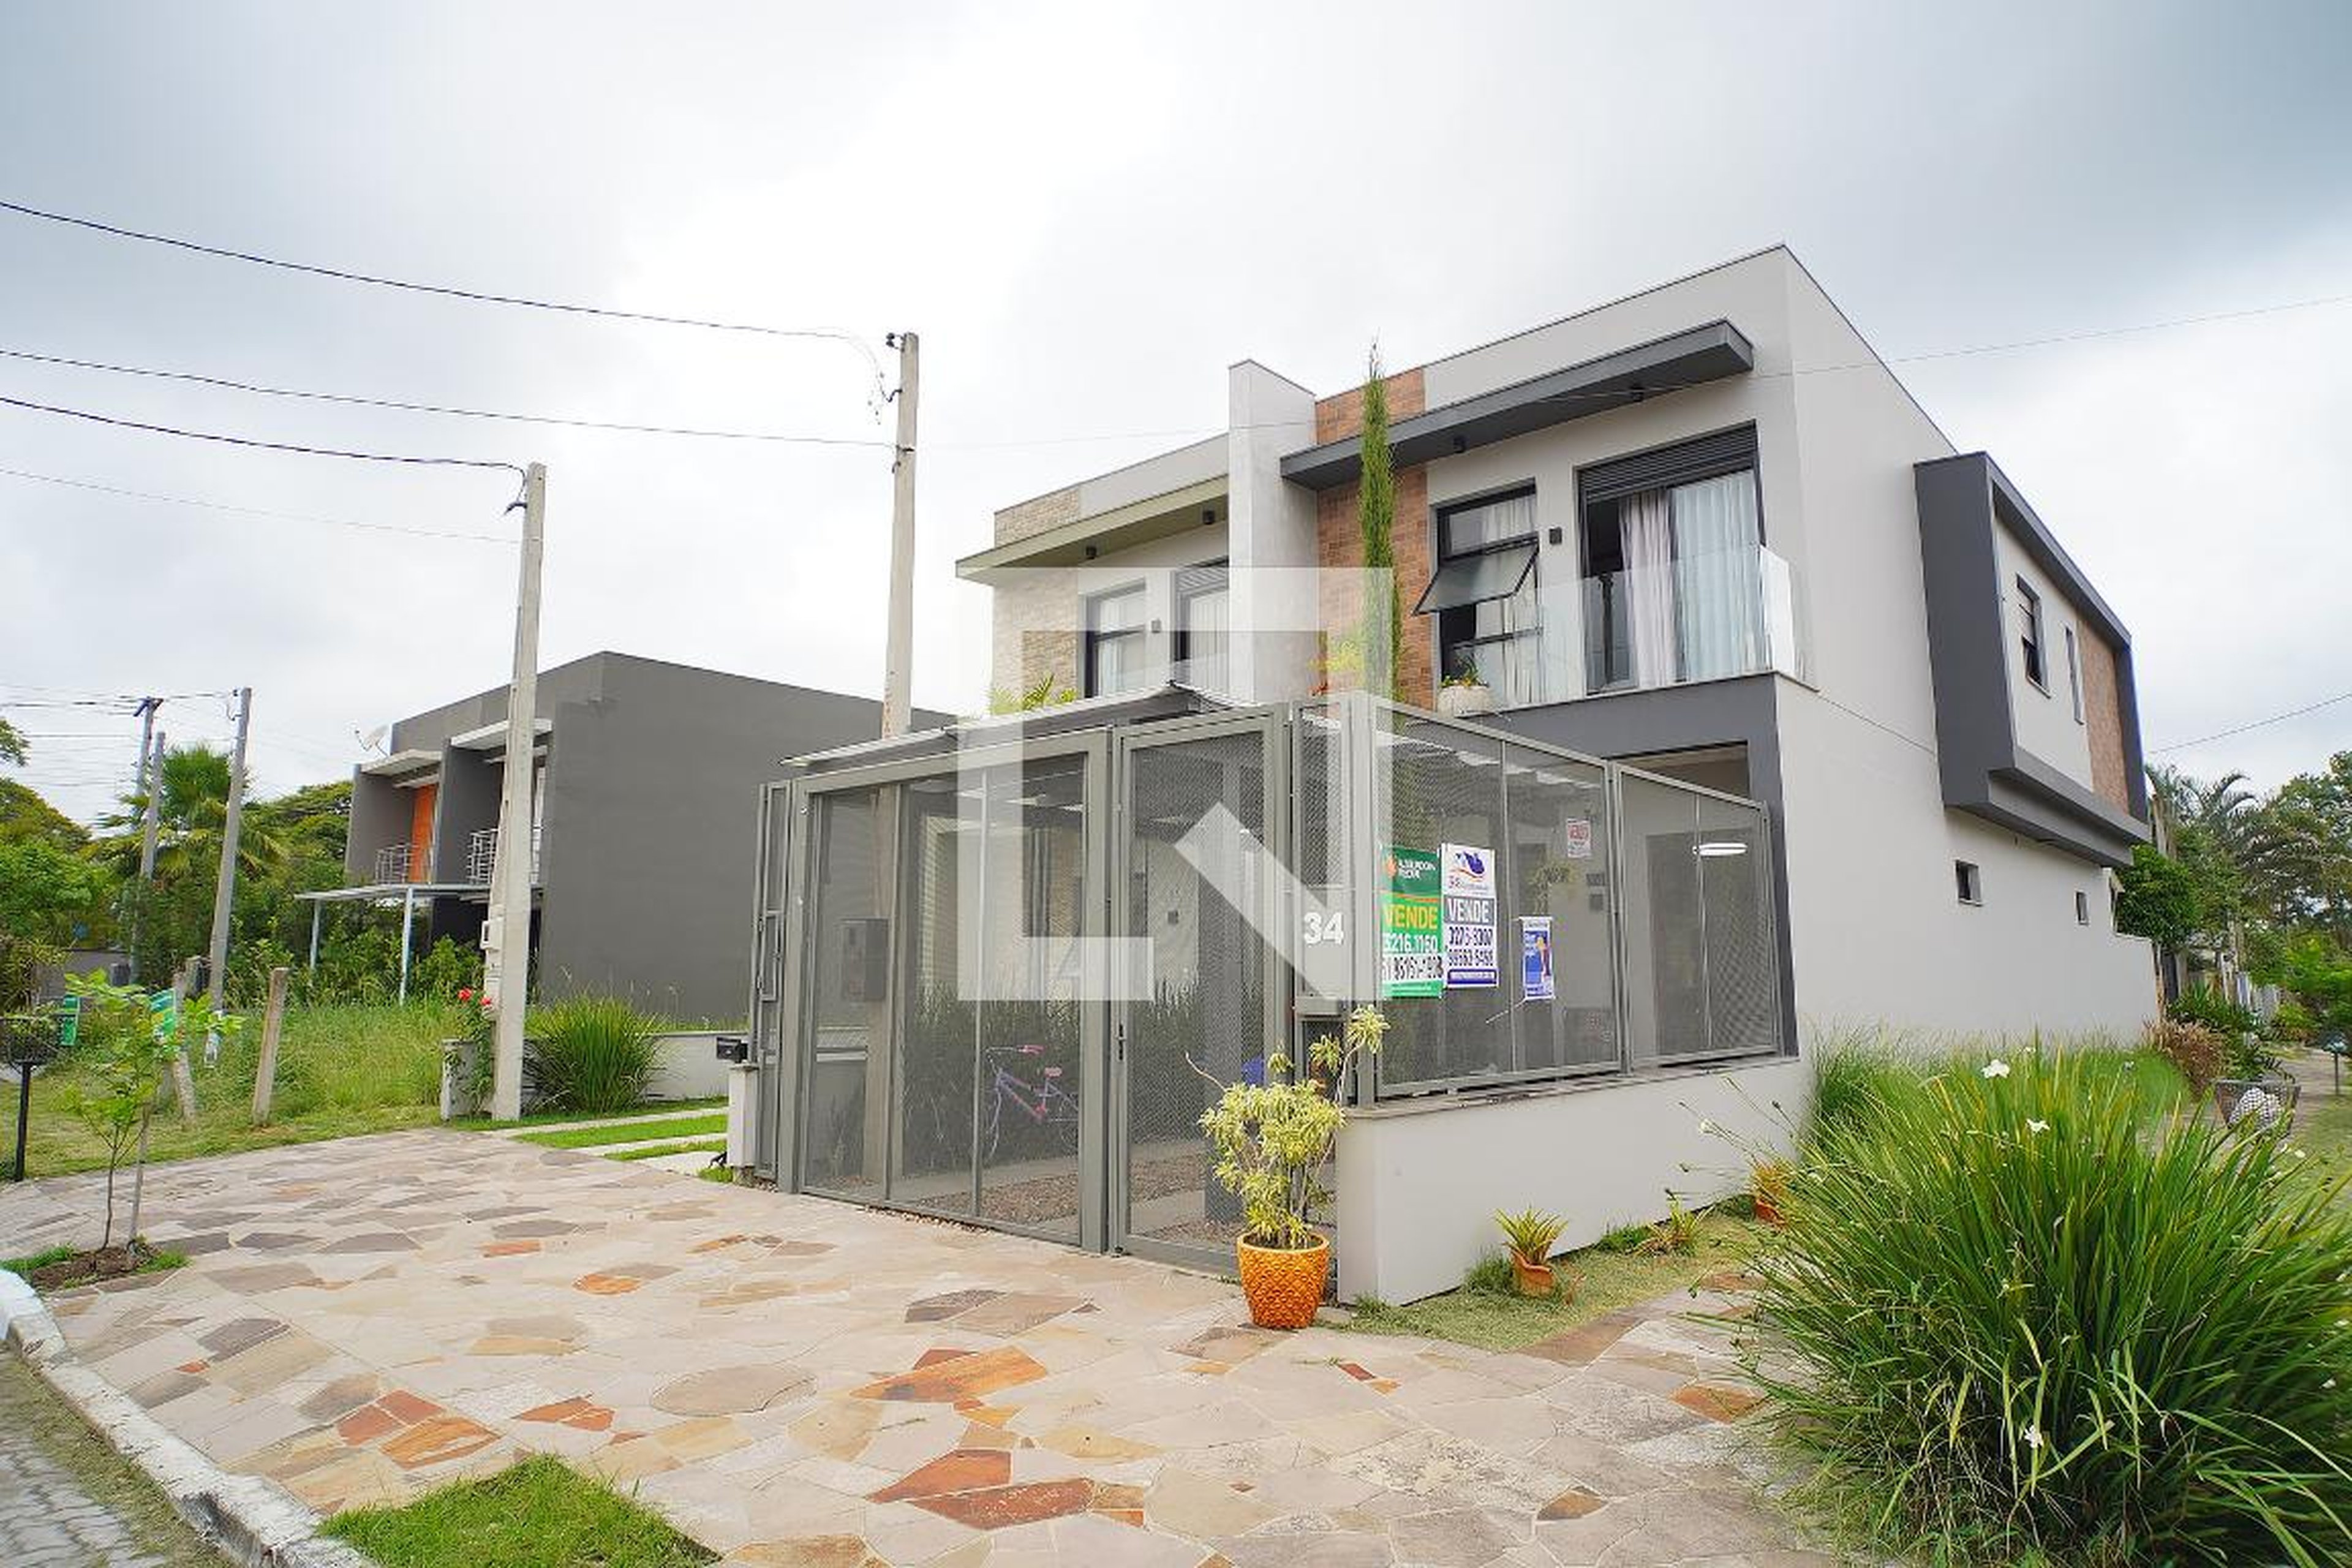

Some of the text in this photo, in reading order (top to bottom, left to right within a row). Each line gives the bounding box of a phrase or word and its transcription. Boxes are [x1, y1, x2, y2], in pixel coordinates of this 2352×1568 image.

[1383, 903, 1438, 929] VENDE
[1448, 898, 1490, 923] VENDE
[1303, 912, 1344, 944] 34
